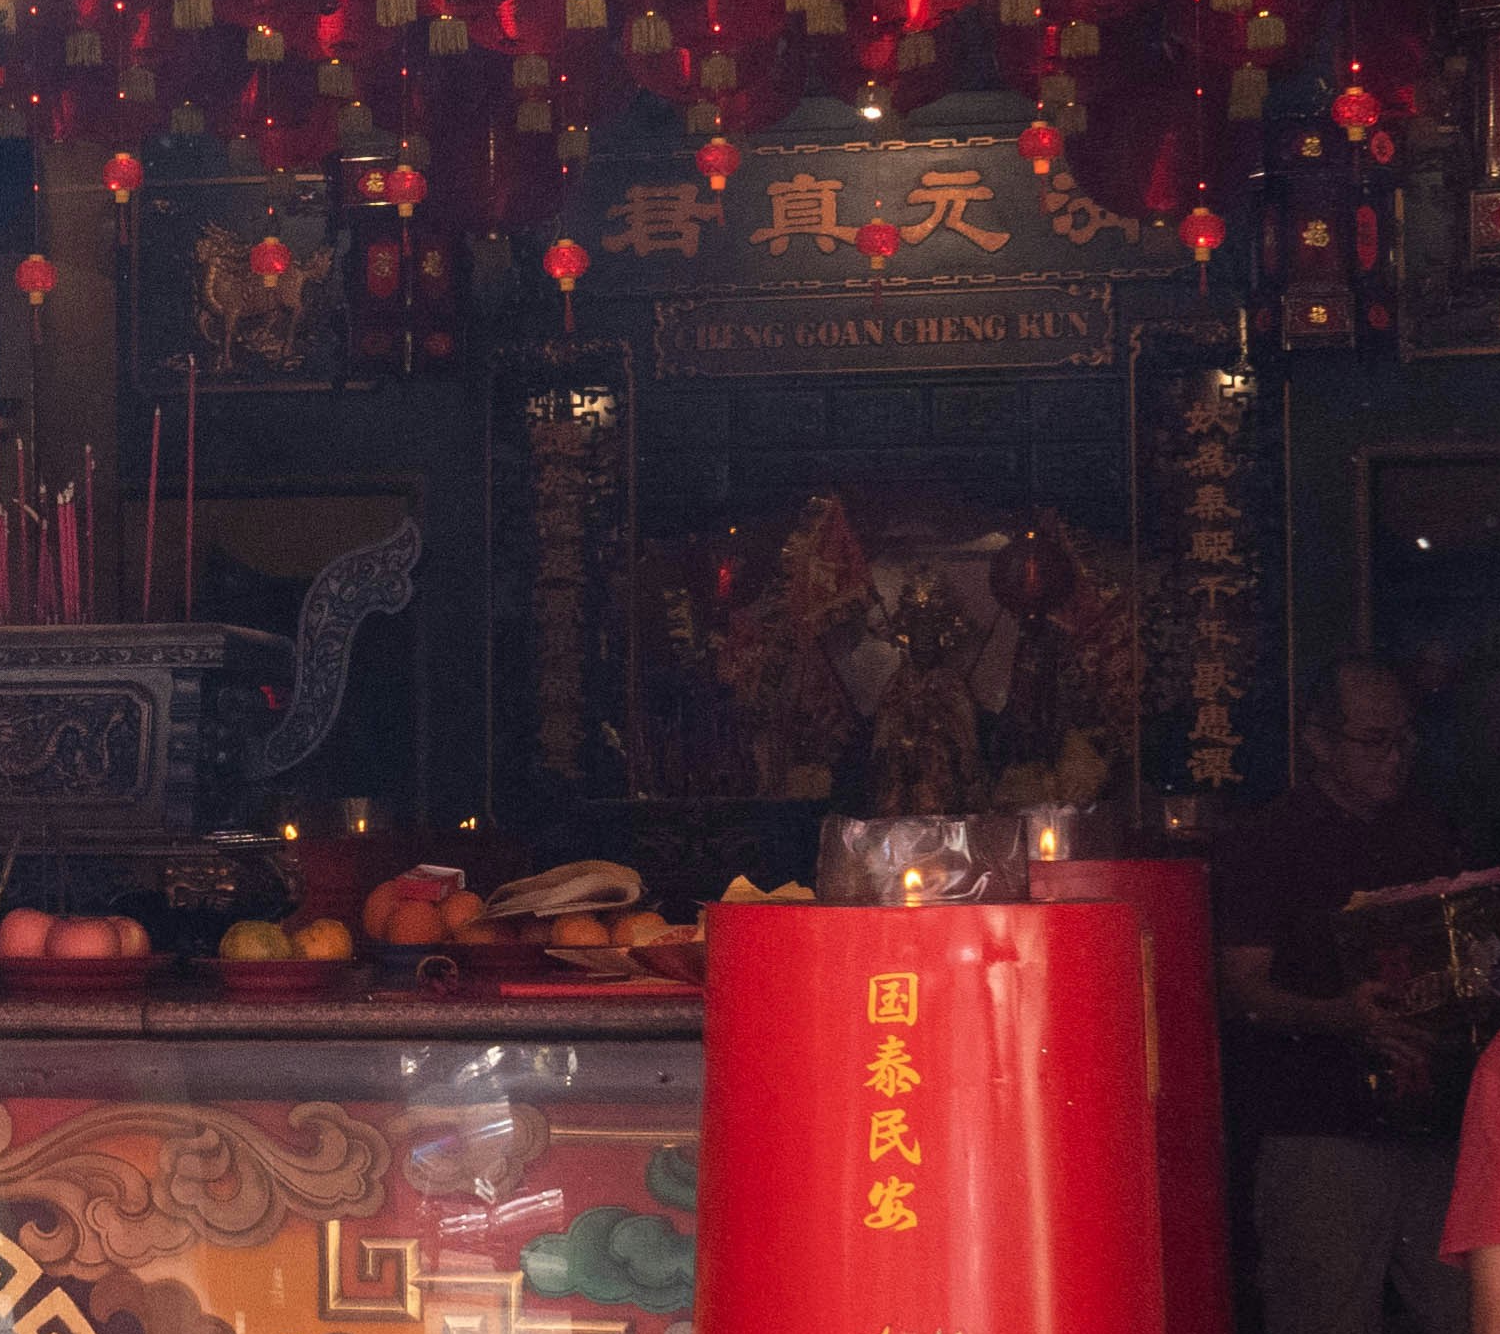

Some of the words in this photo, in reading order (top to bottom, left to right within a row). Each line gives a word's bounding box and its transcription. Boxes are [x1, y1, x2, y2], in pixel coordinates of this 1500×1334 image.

[794, 317, 885, 349] GOAN
[893, 313, 1007, 347] CHENG
[1016, 310, 1091, 340] KUN
[863, 972, 922, 1231] 国泰民安
